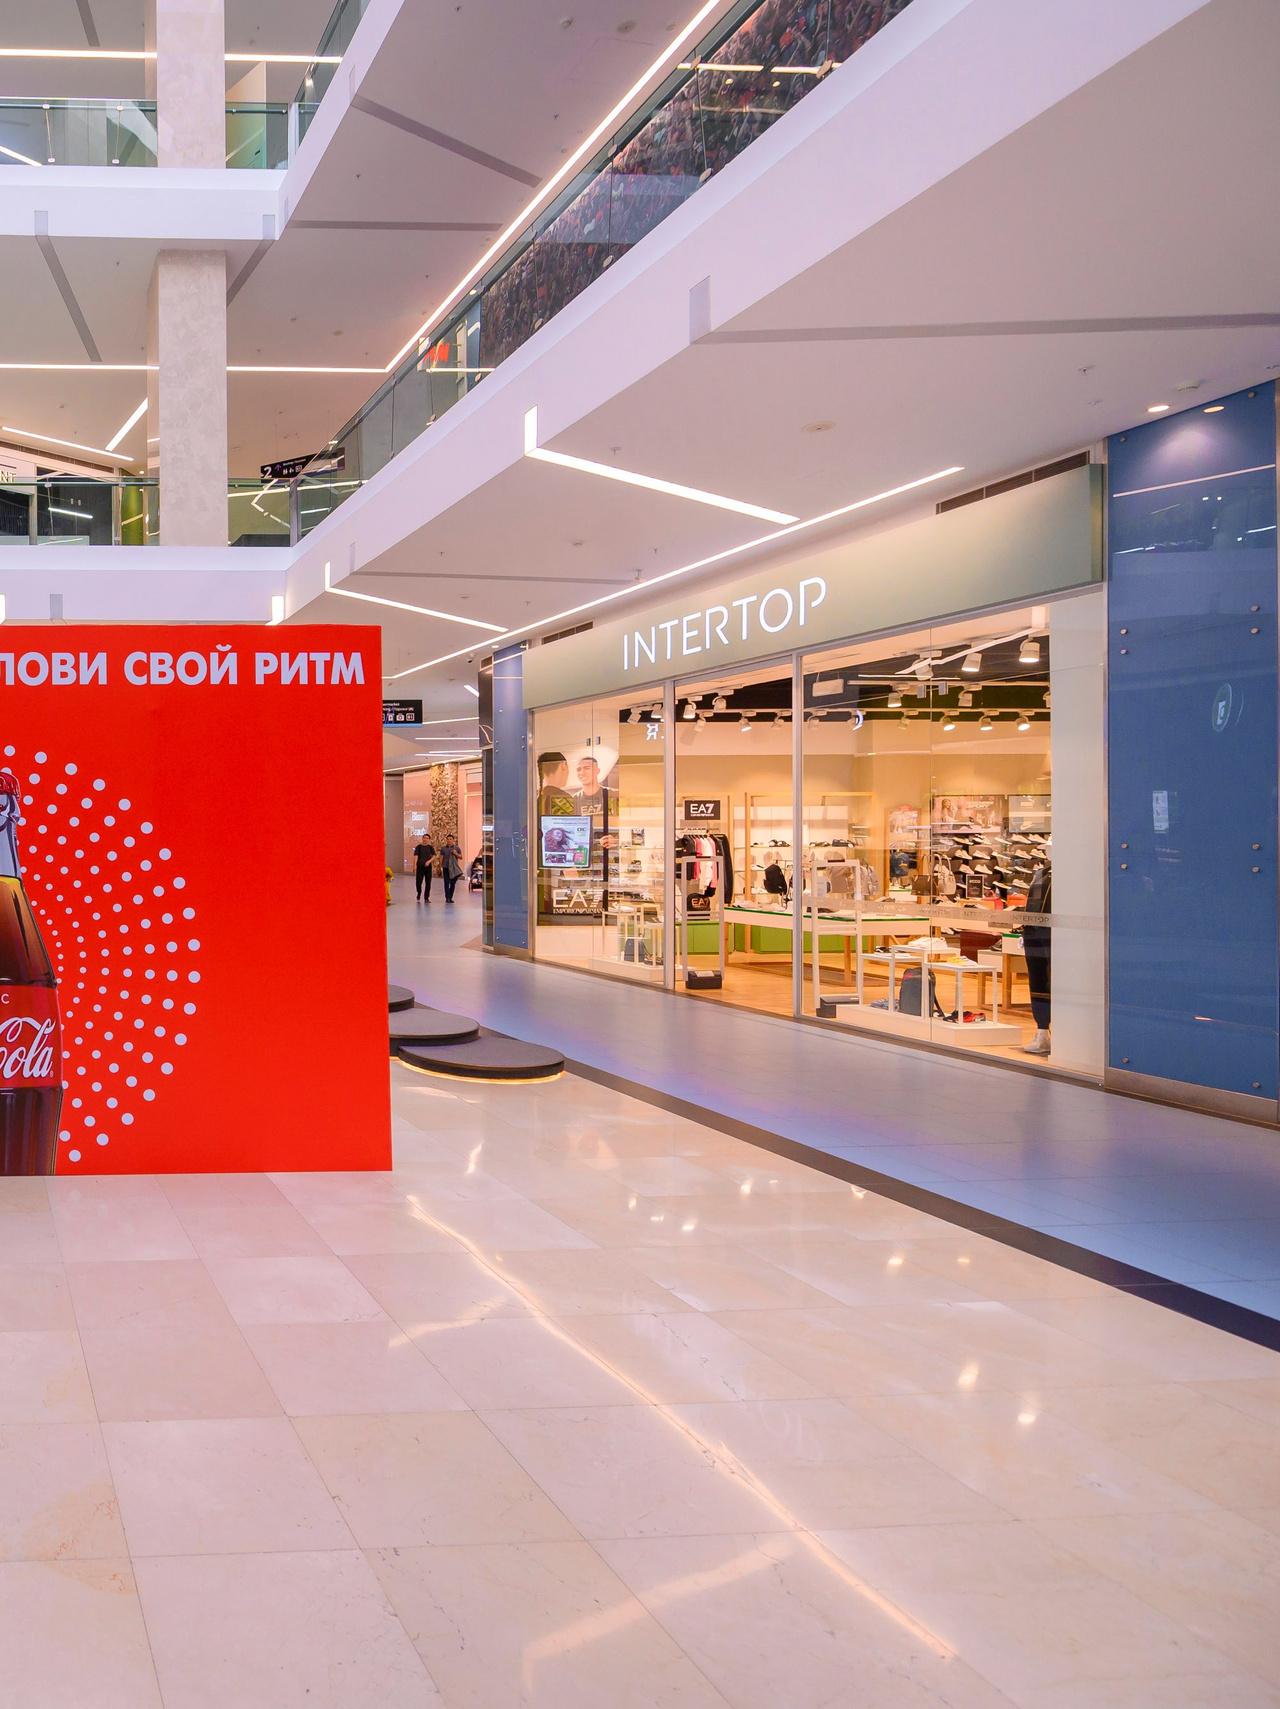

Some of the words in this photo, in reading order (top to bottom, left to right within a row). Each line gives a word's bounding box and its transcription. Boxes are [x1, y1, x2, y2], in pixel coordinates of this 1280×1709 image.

[263, 466, 273, 479] 2
[623, 576, 827, 670] INTERTOP
[123, 643, 238, 686] СВОЙ
[255, 651, 365, 685] РИТМ
[690, 803, 715, 814] EA7
